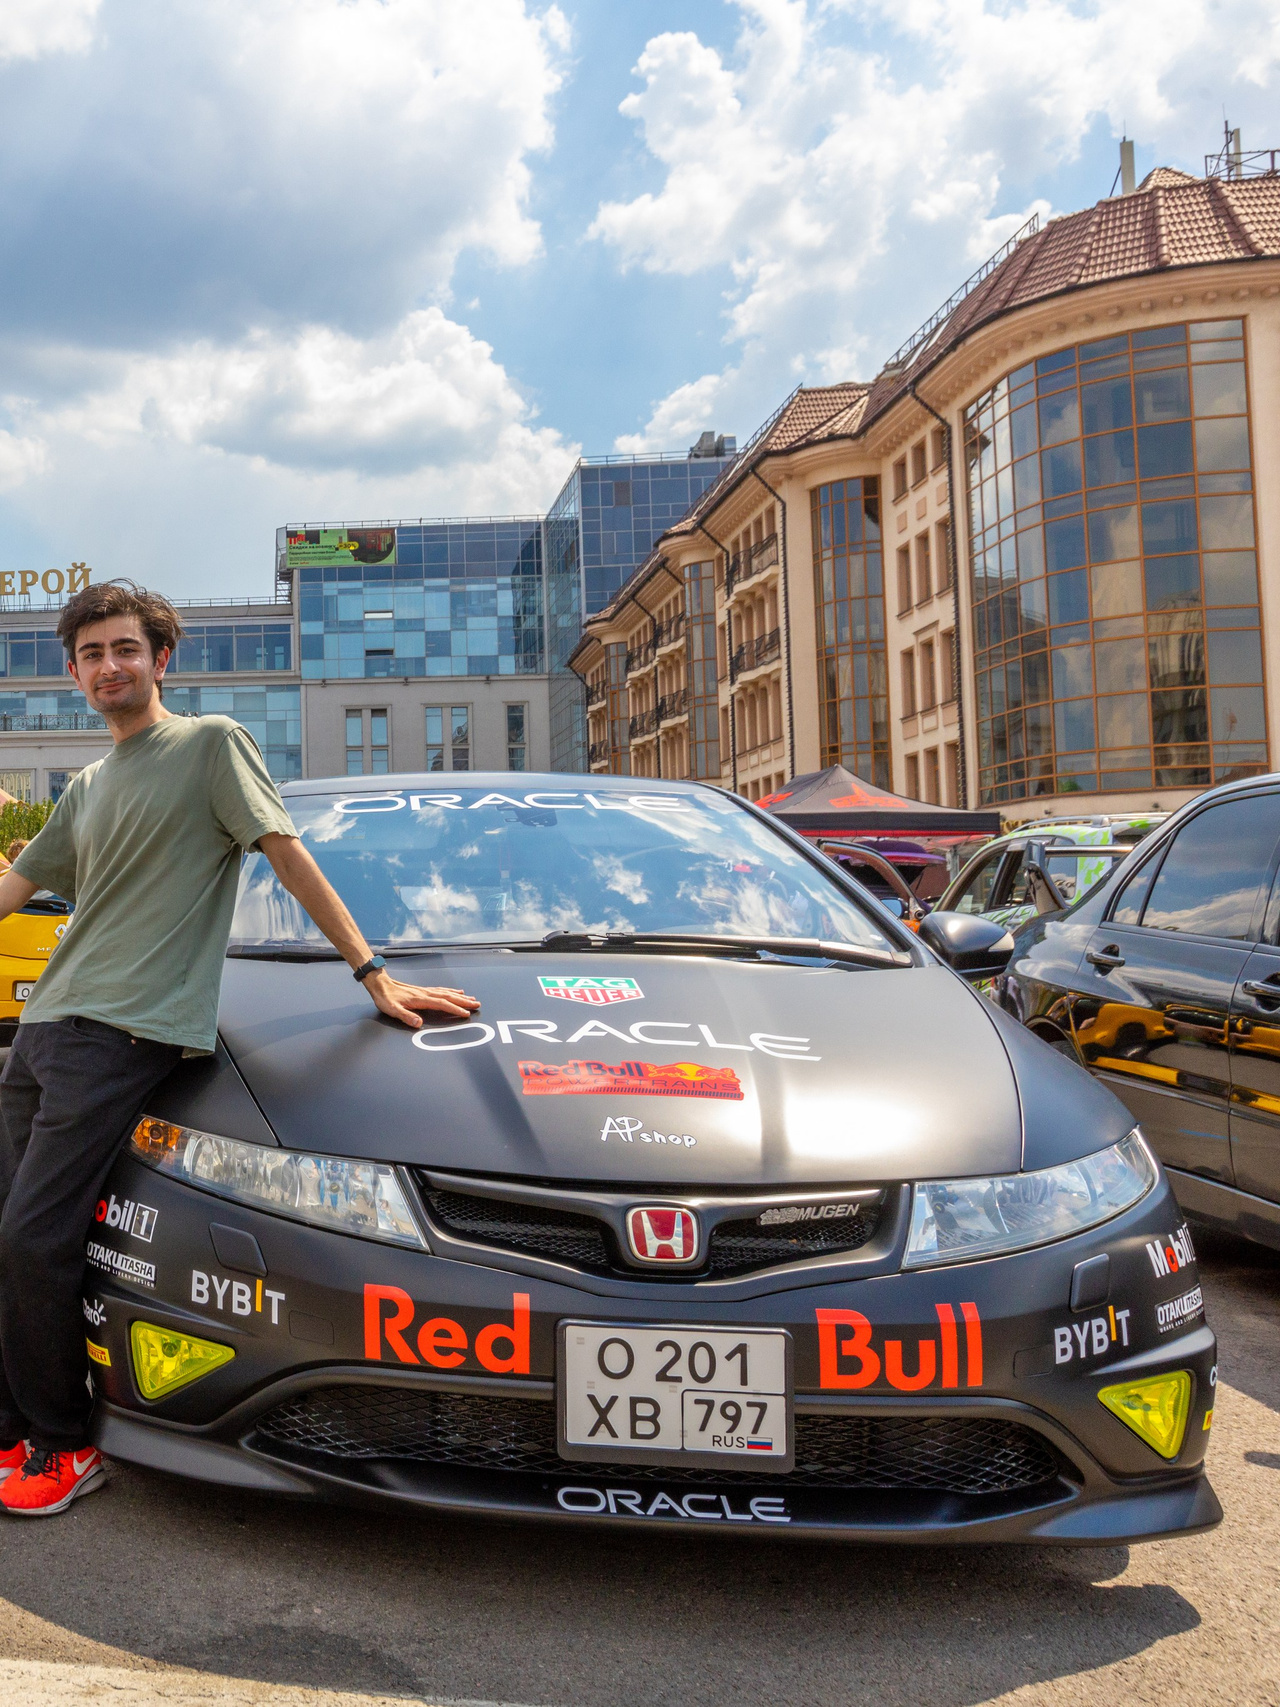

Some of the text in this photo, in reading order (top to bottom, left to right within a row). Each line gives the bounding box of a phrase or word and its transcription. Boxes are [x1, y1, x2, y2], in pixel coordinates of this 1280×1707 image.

[333, 792, 692, 814] ORACLE
[545, 978, 631, 989] TAG
[548, 988, 640, 1003] HEUER
[411, 1019, 822, 1062] ORACLE
[521, 1062, 645, 1077] Red Bull
[525, 1078, 739, 1092] POWERTRAINS
[95, 1194, 135, 1232] obil
[798, 1203, 860, 1221] MUGEN
[191, 1270, 286, 1325] BYBIT
[363, 1283, 983, 1391] Red Bull
[1054, 1305, 1130, 1365] BYBIT
[655, 1339, 748, 1387] 201
[693, 1398, 768, 1435] 797
[712, 1434, 745, 1450] RUS
[557, 1486, 792, 1523] ORACLE
